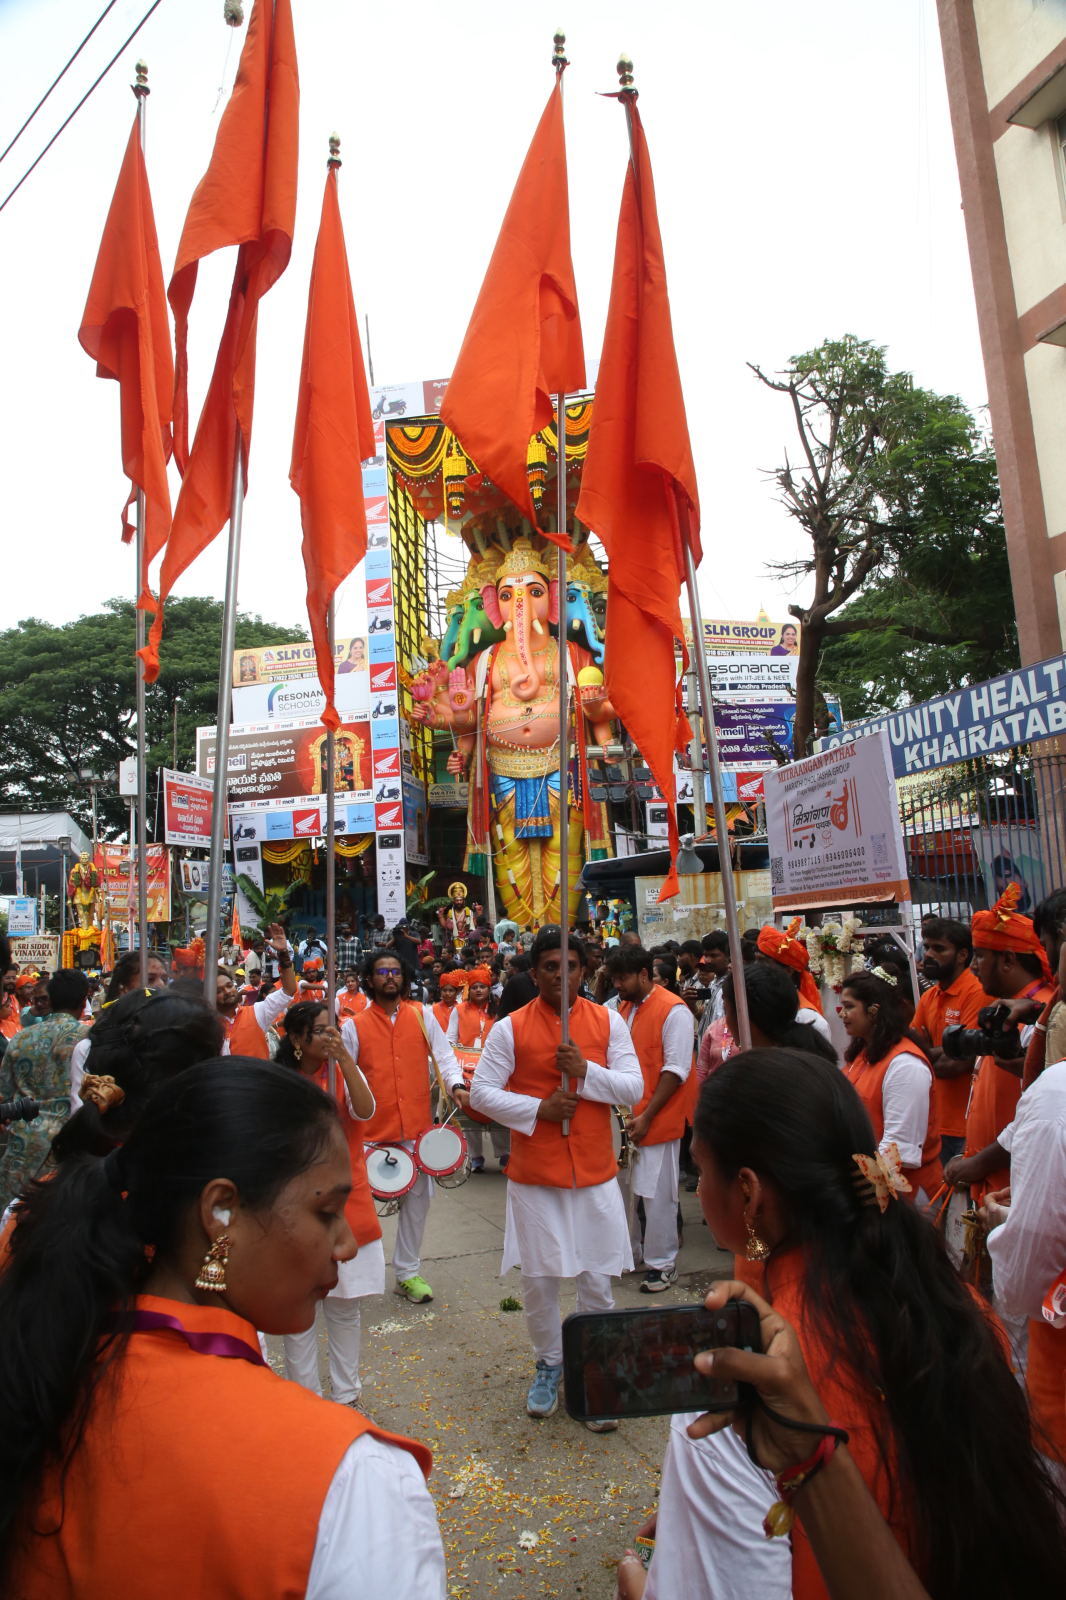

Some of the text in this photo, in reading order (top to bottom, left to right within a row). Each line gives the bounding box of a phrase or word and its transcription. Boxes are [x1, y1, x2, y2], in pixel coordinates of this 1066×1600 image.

[704, 624, 776, 638] SLN GROUP
[276, 648, 301, 661] SLN
[707, 664, 790, 674] esonance
[970, 659, 1066, 721] HEALT
[278, 699, 321, 712] SCHOOLS
[723, 727, 744, 736] meil
[823, 743, 857, 766] PATHAK
[832, 762, 850, 776] GROUP
[14, 949, 53, 957] VINAYAKA
